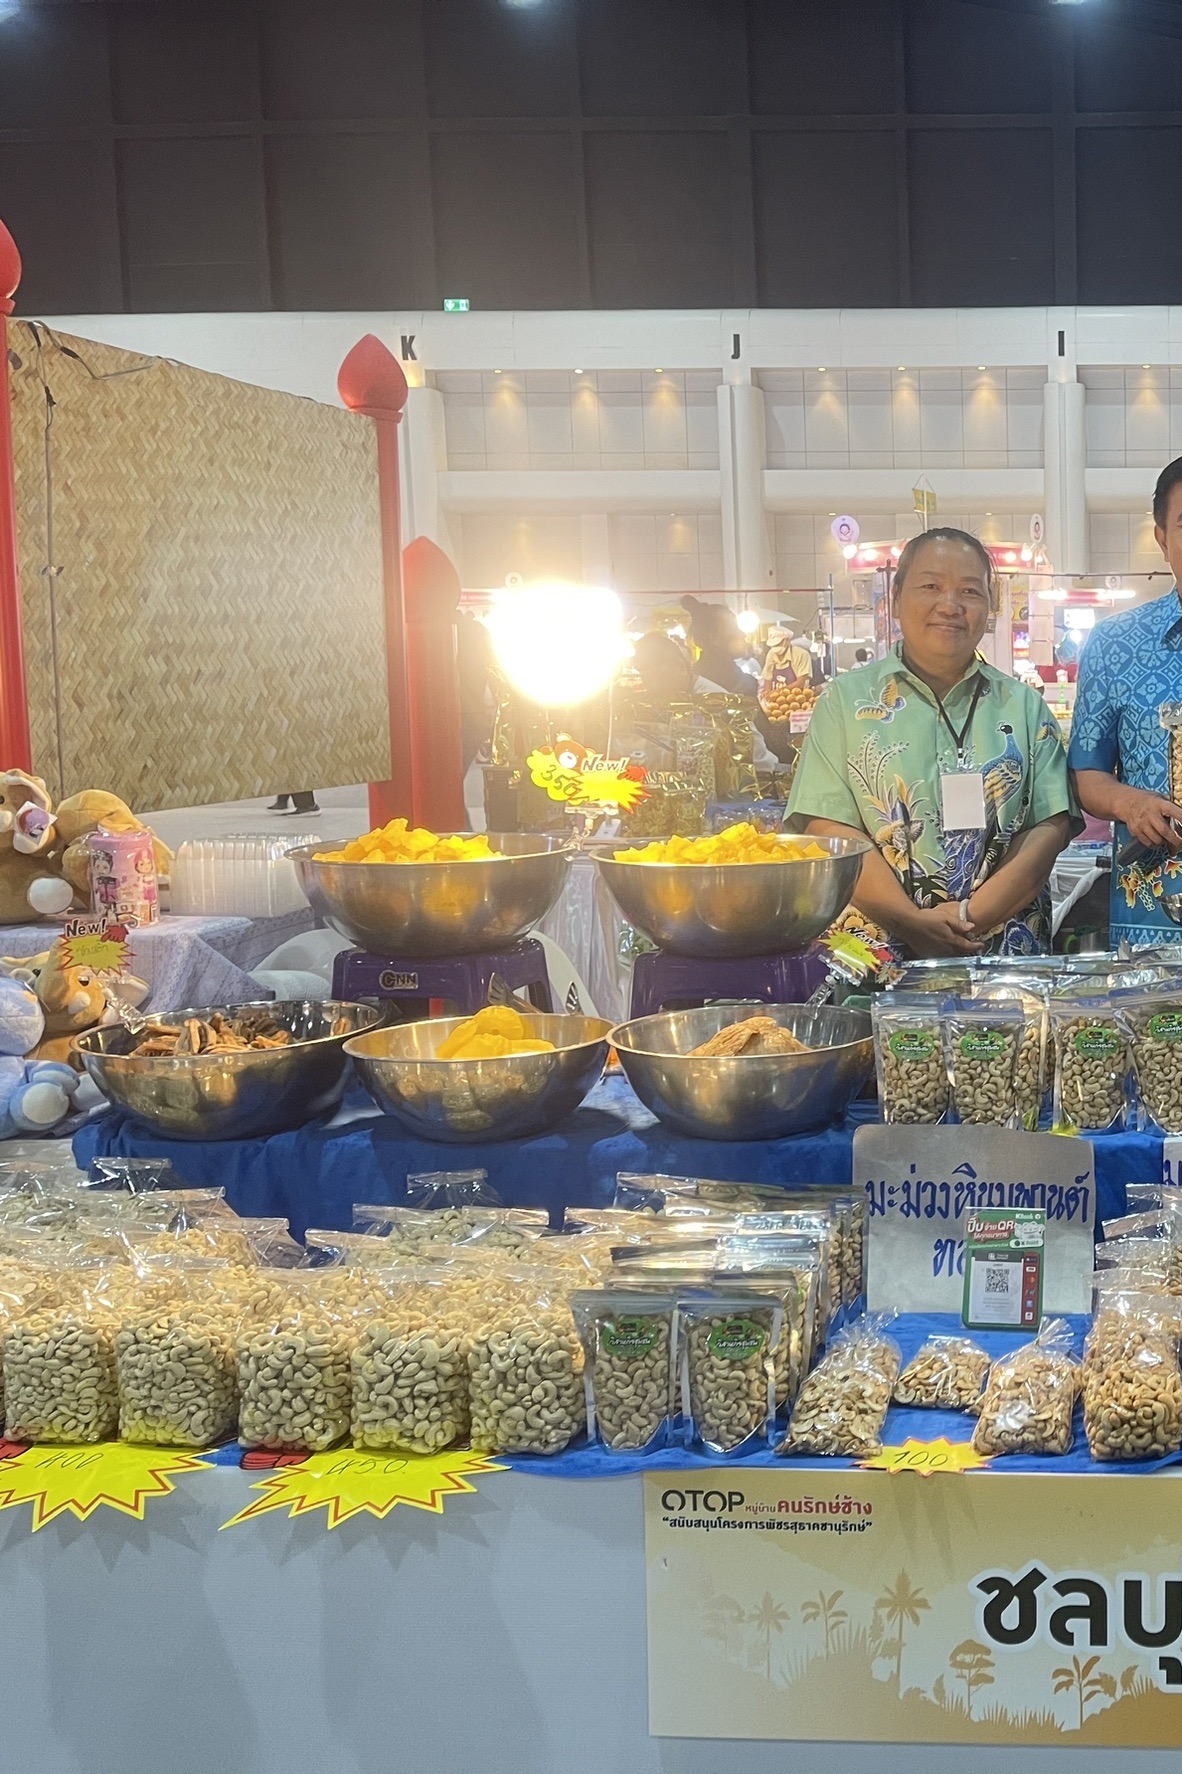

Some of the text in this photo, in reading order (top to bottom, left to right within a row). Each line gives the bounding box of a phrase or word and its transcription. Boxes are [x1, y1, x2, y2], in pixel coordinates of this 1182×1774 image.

[400, 335, 416, 360] K
[730, 334, 741, 359] J
[582, 756, 628, 772] New!
[66, 918, 107, 937] New!
[997, 1220, 1014, 1231] QR
[34, 1451, 104, 1470] 400
[894, 1450, 949, 1467] 100
[661, 1489, 873, 1516] OTOP หมู่บ้าน คนรักษ์ช้าง
